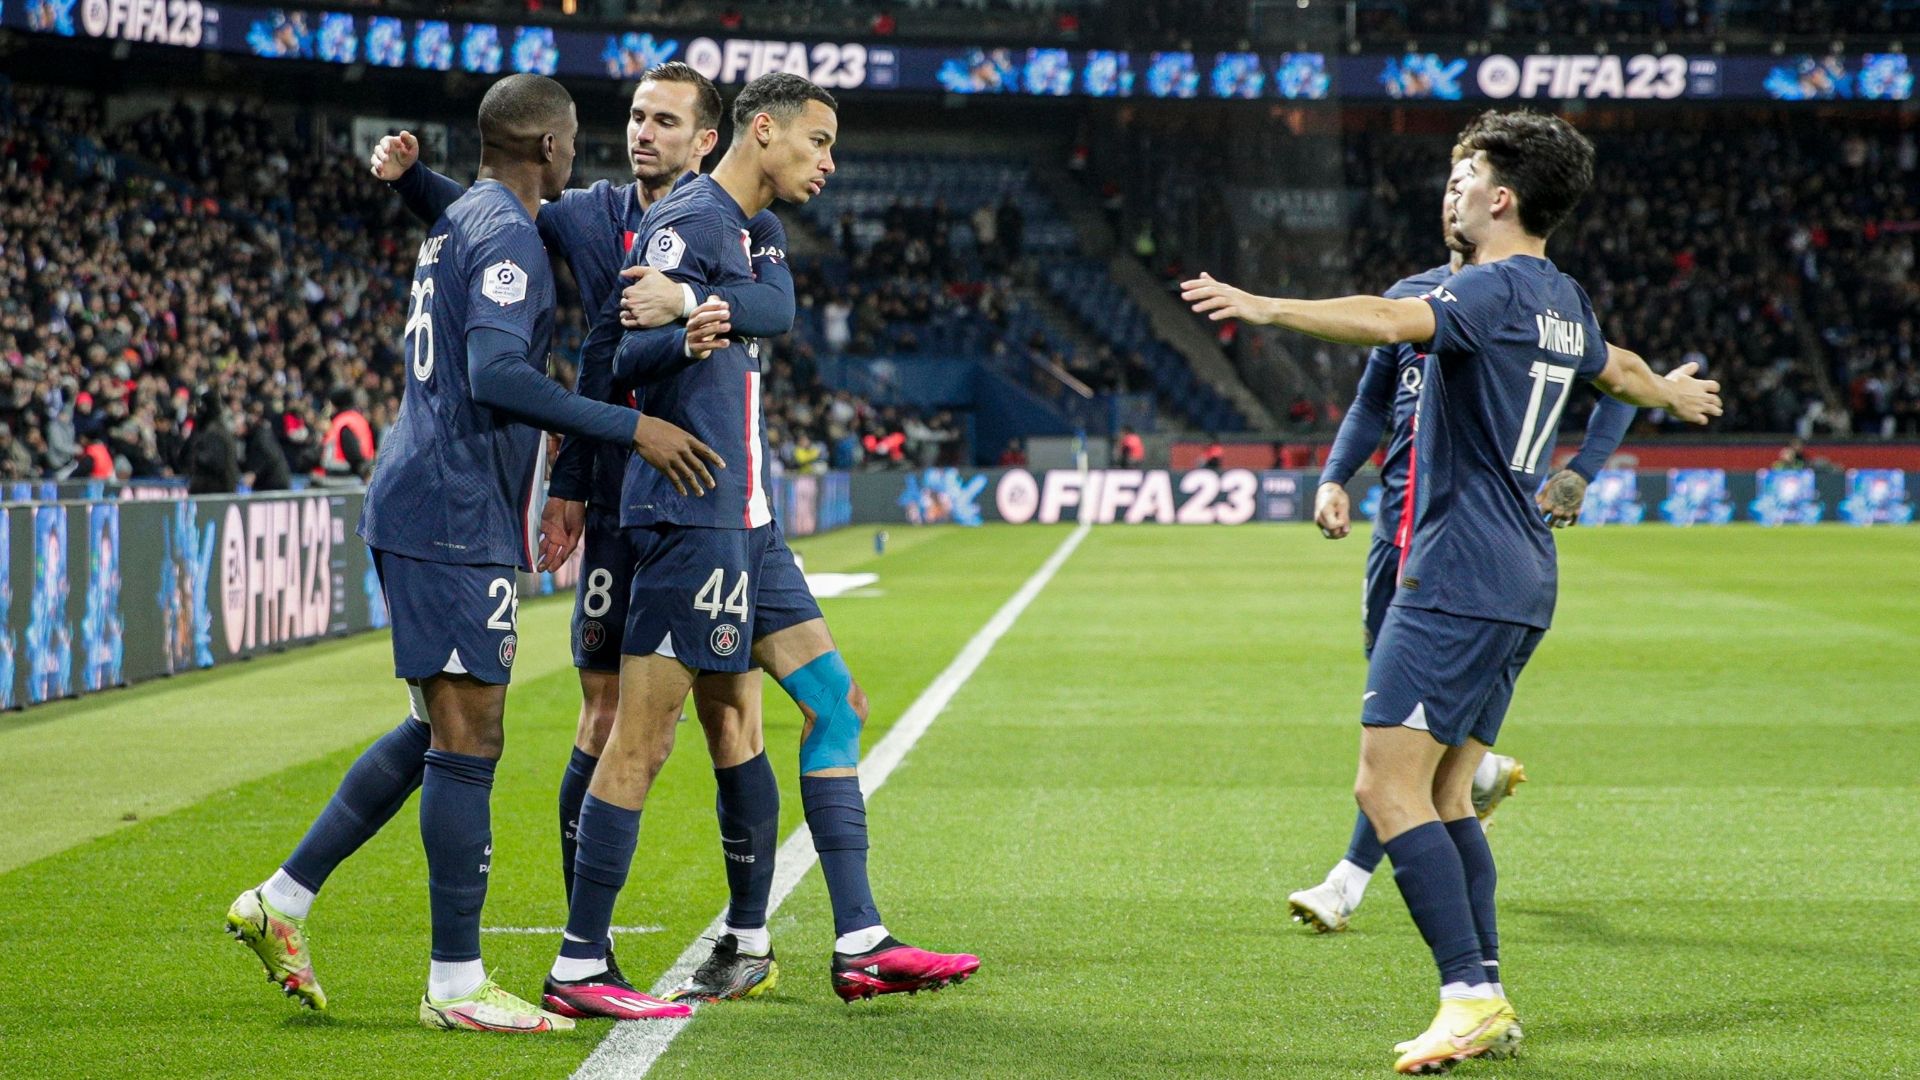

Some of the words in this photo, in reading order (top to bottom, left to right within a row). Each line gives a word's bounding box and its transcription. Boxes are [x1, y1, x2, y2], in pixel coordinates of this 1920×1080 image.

[107, 0, 168, 43] FIFA
[168, 0, 203, 48] 23
[720, 38, 811, 84] FIFA
[811, 42, 867, 89] 23
[1519, 54, 1625, 99] FIFA
[1624, 54, 1688, 99] 23
[1509, 361, 1575, 474] 17
[1038, 468, 1176, 524] FIFA
[1176, 468, 1259, 524] 23
[246, 502, 302, 650] FIFA
[302, 496, 331, 637] 23
[583, 567, 613, 618] 8
[693, 568, 749, 623] 44
